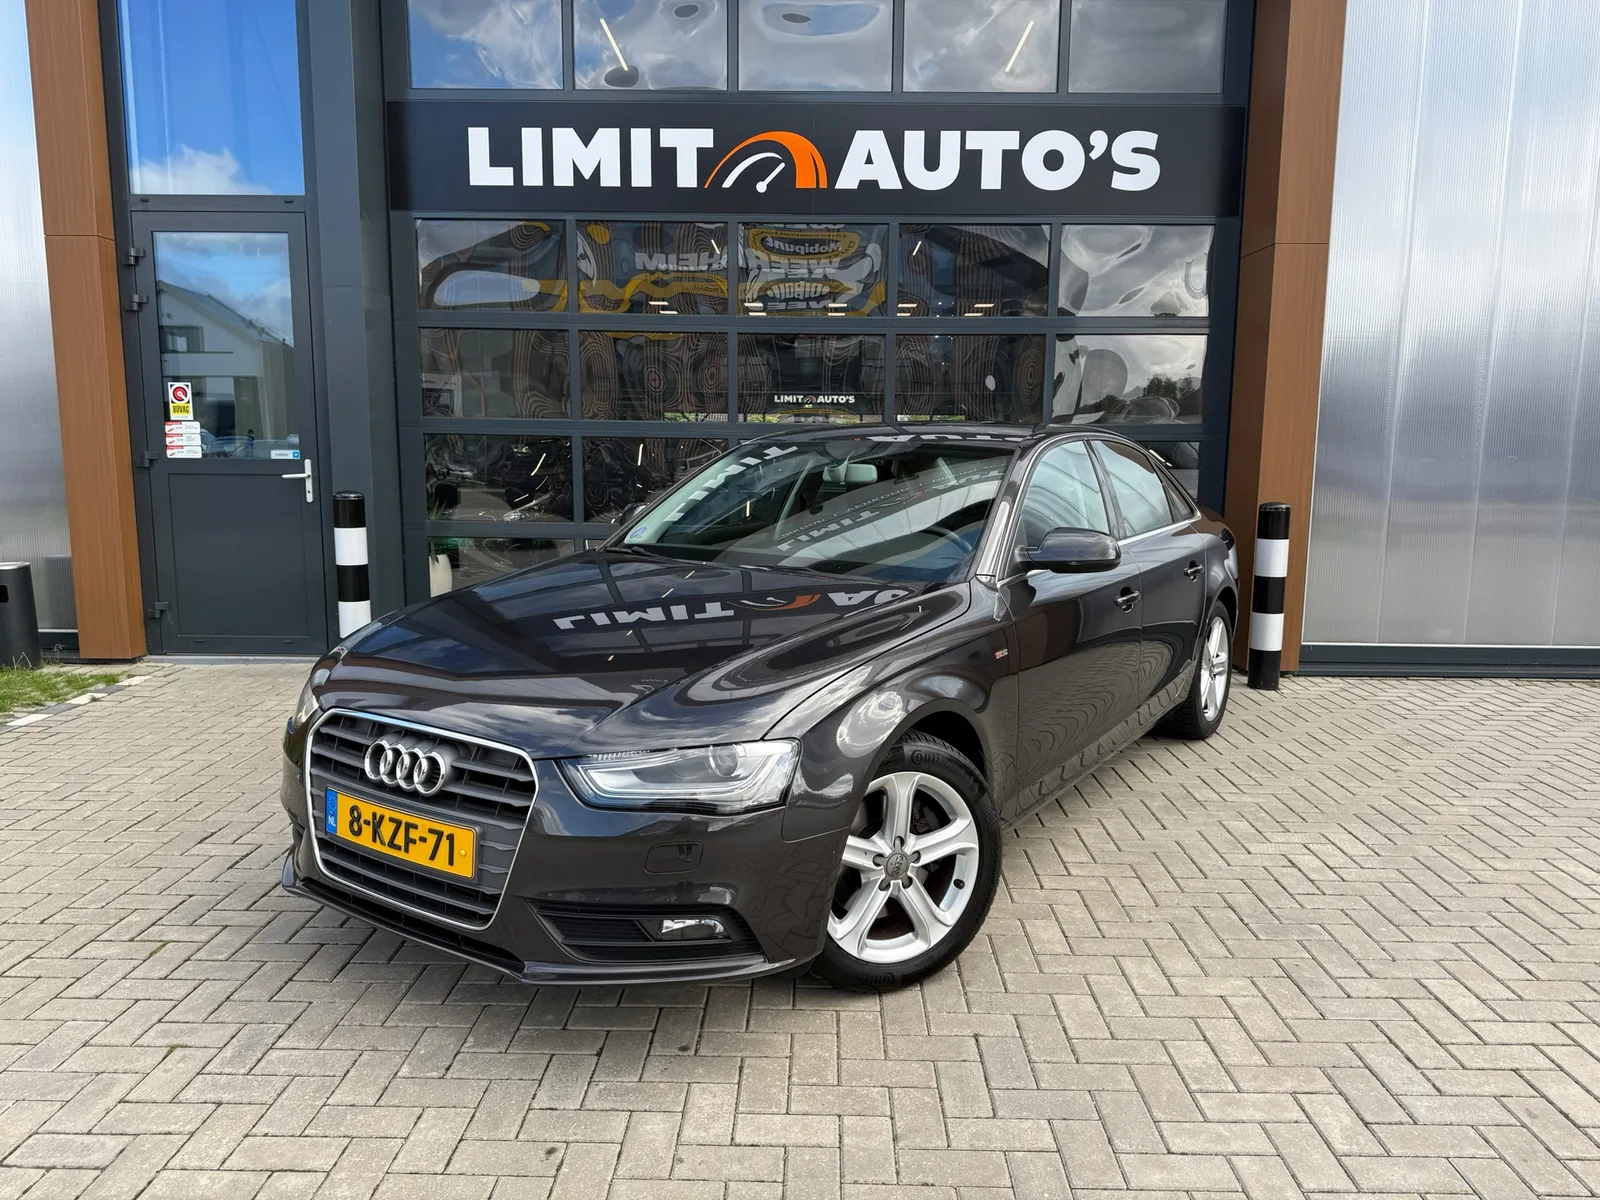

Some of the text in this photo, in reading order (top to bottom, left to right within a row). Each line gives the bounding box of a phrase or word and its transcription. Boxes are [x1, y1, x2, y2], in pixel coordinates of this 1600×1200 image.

[467, 127, 1161, 191] LIMIT AUTO'S
[774, 395, 855, 403] LIMIT AUTO'S
[172, 404, 190, 414] BOVAG
[328, 815, 337, 827] NL
[348, 804, 455, 867] 8-KZF-71
